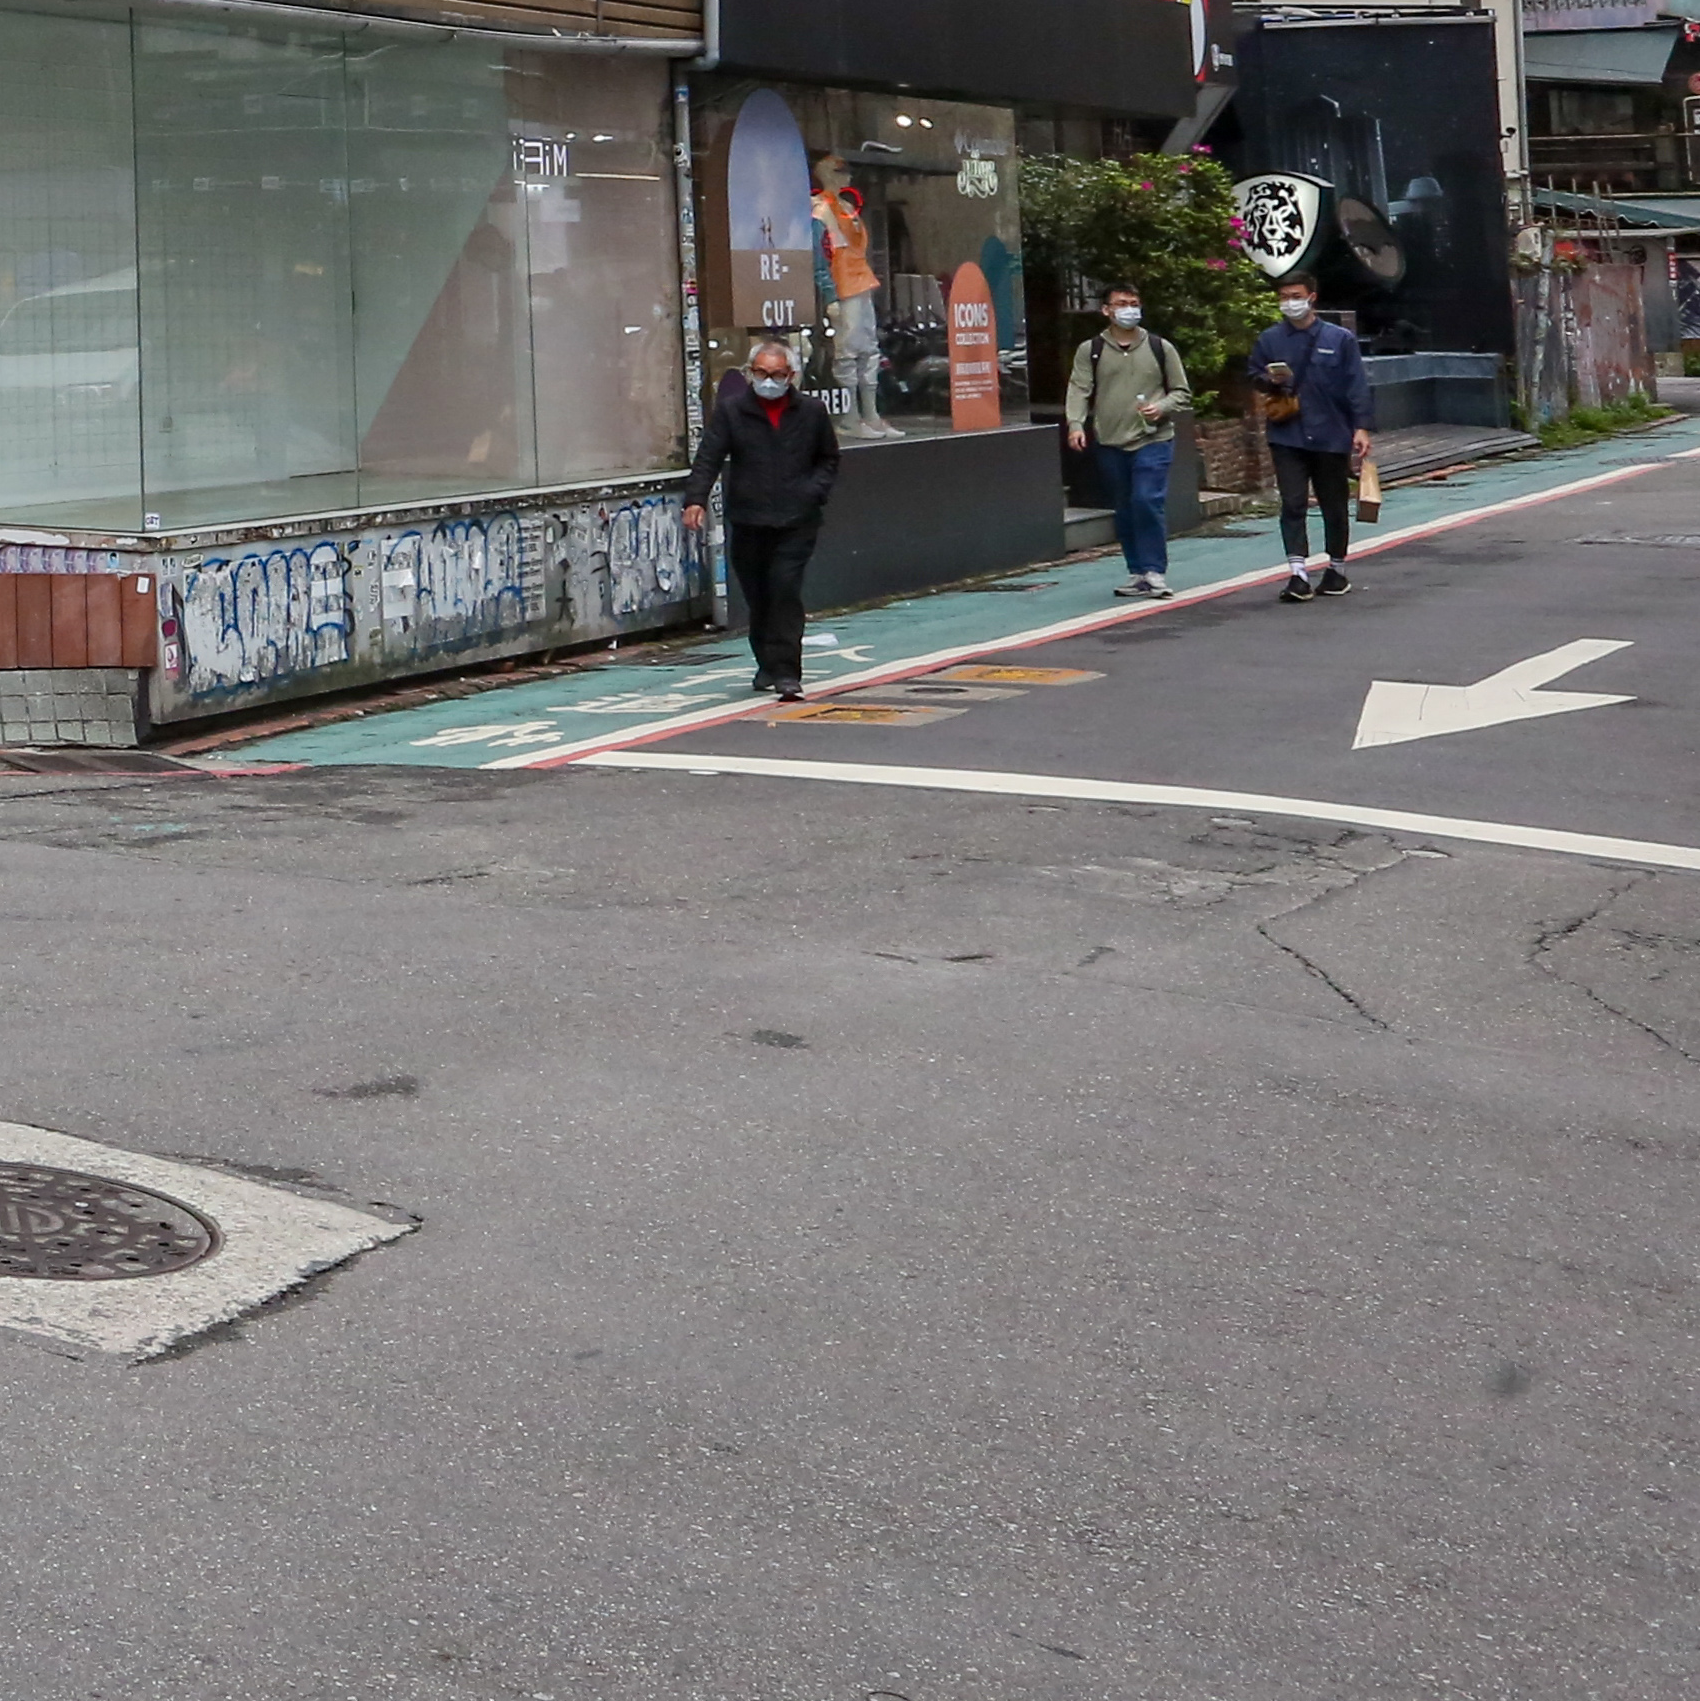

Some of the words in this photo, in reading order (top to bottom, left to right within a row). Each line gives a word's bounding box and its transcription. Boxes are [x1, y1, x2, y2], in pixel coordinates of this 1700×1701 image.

[760, 254, 789, 280] RE-
[763, 300, 794, 326] CUT
[954, 303, 988, 328] ICONS
